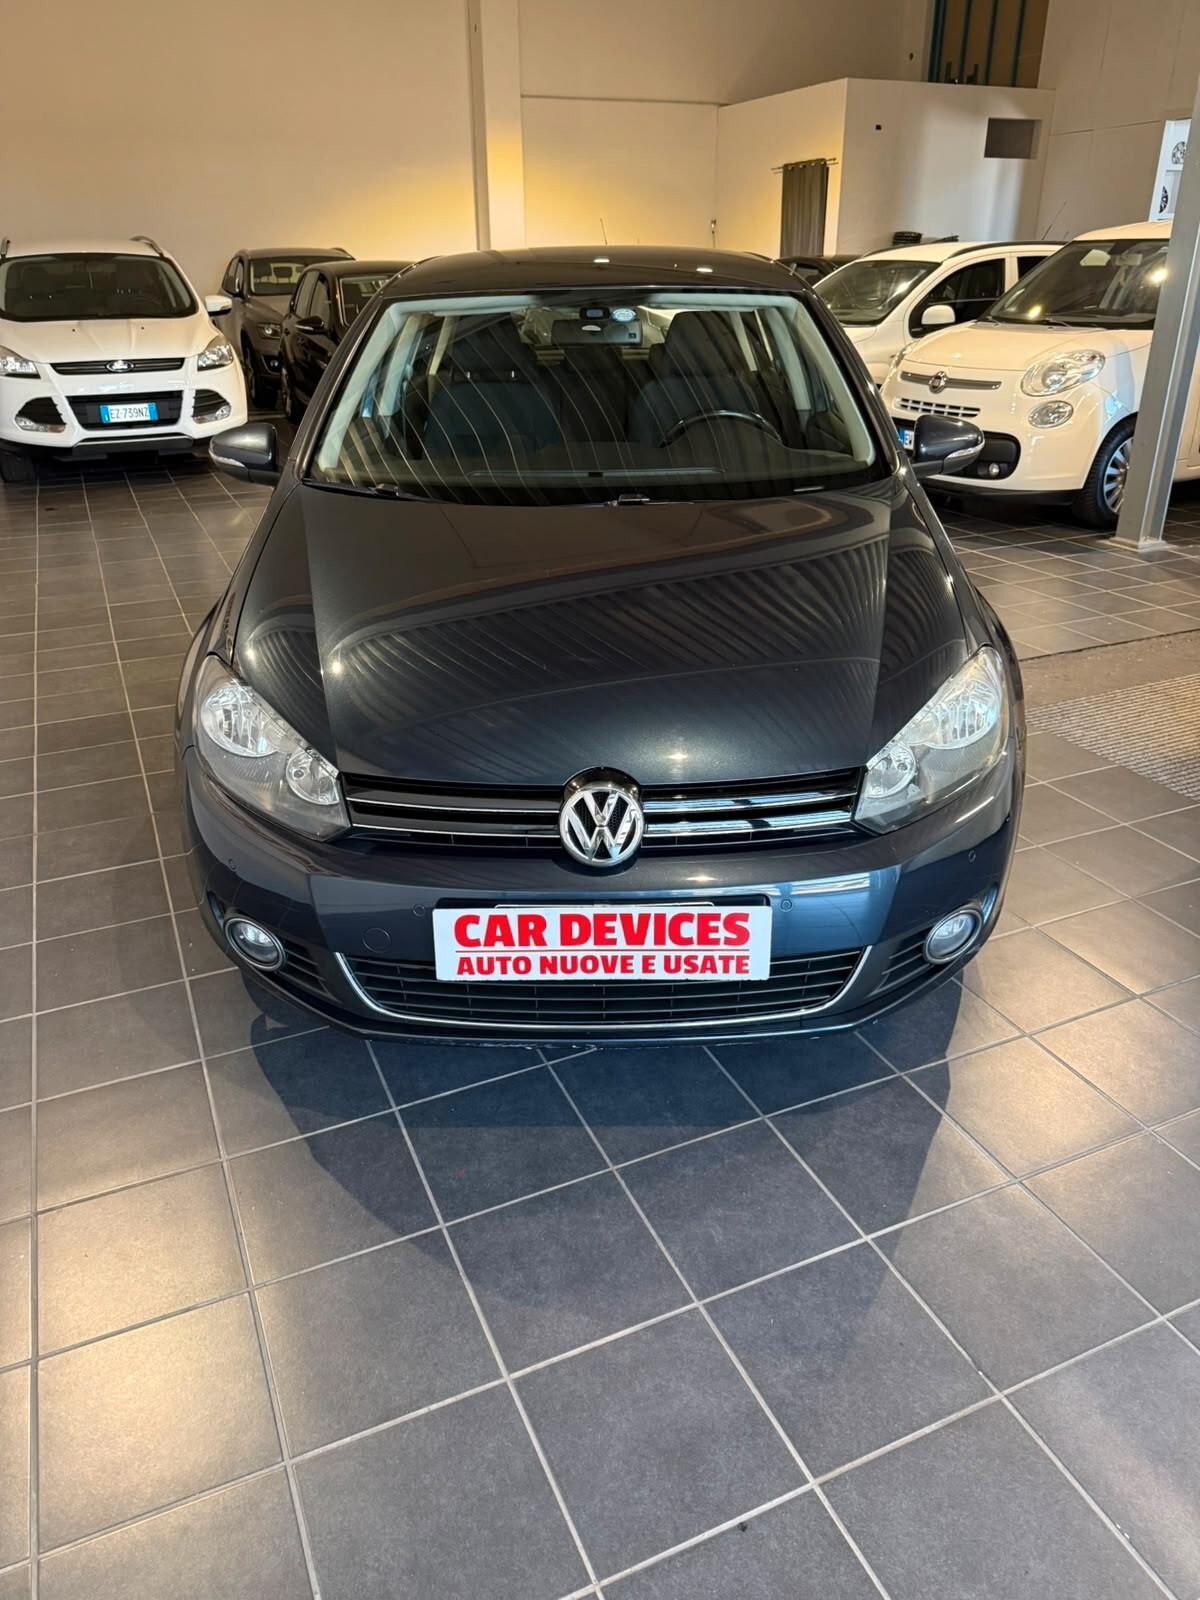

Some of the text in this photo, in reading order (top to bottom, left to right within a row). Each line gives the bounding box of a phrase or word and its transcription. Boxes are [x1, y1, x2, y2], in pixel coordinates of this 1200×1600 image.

[562, 789, 640, 862] VW
[454, 912, 750, 948] CAR DEVICES
[457, 955, 749, 976] AUTO NUOVE E USATE
